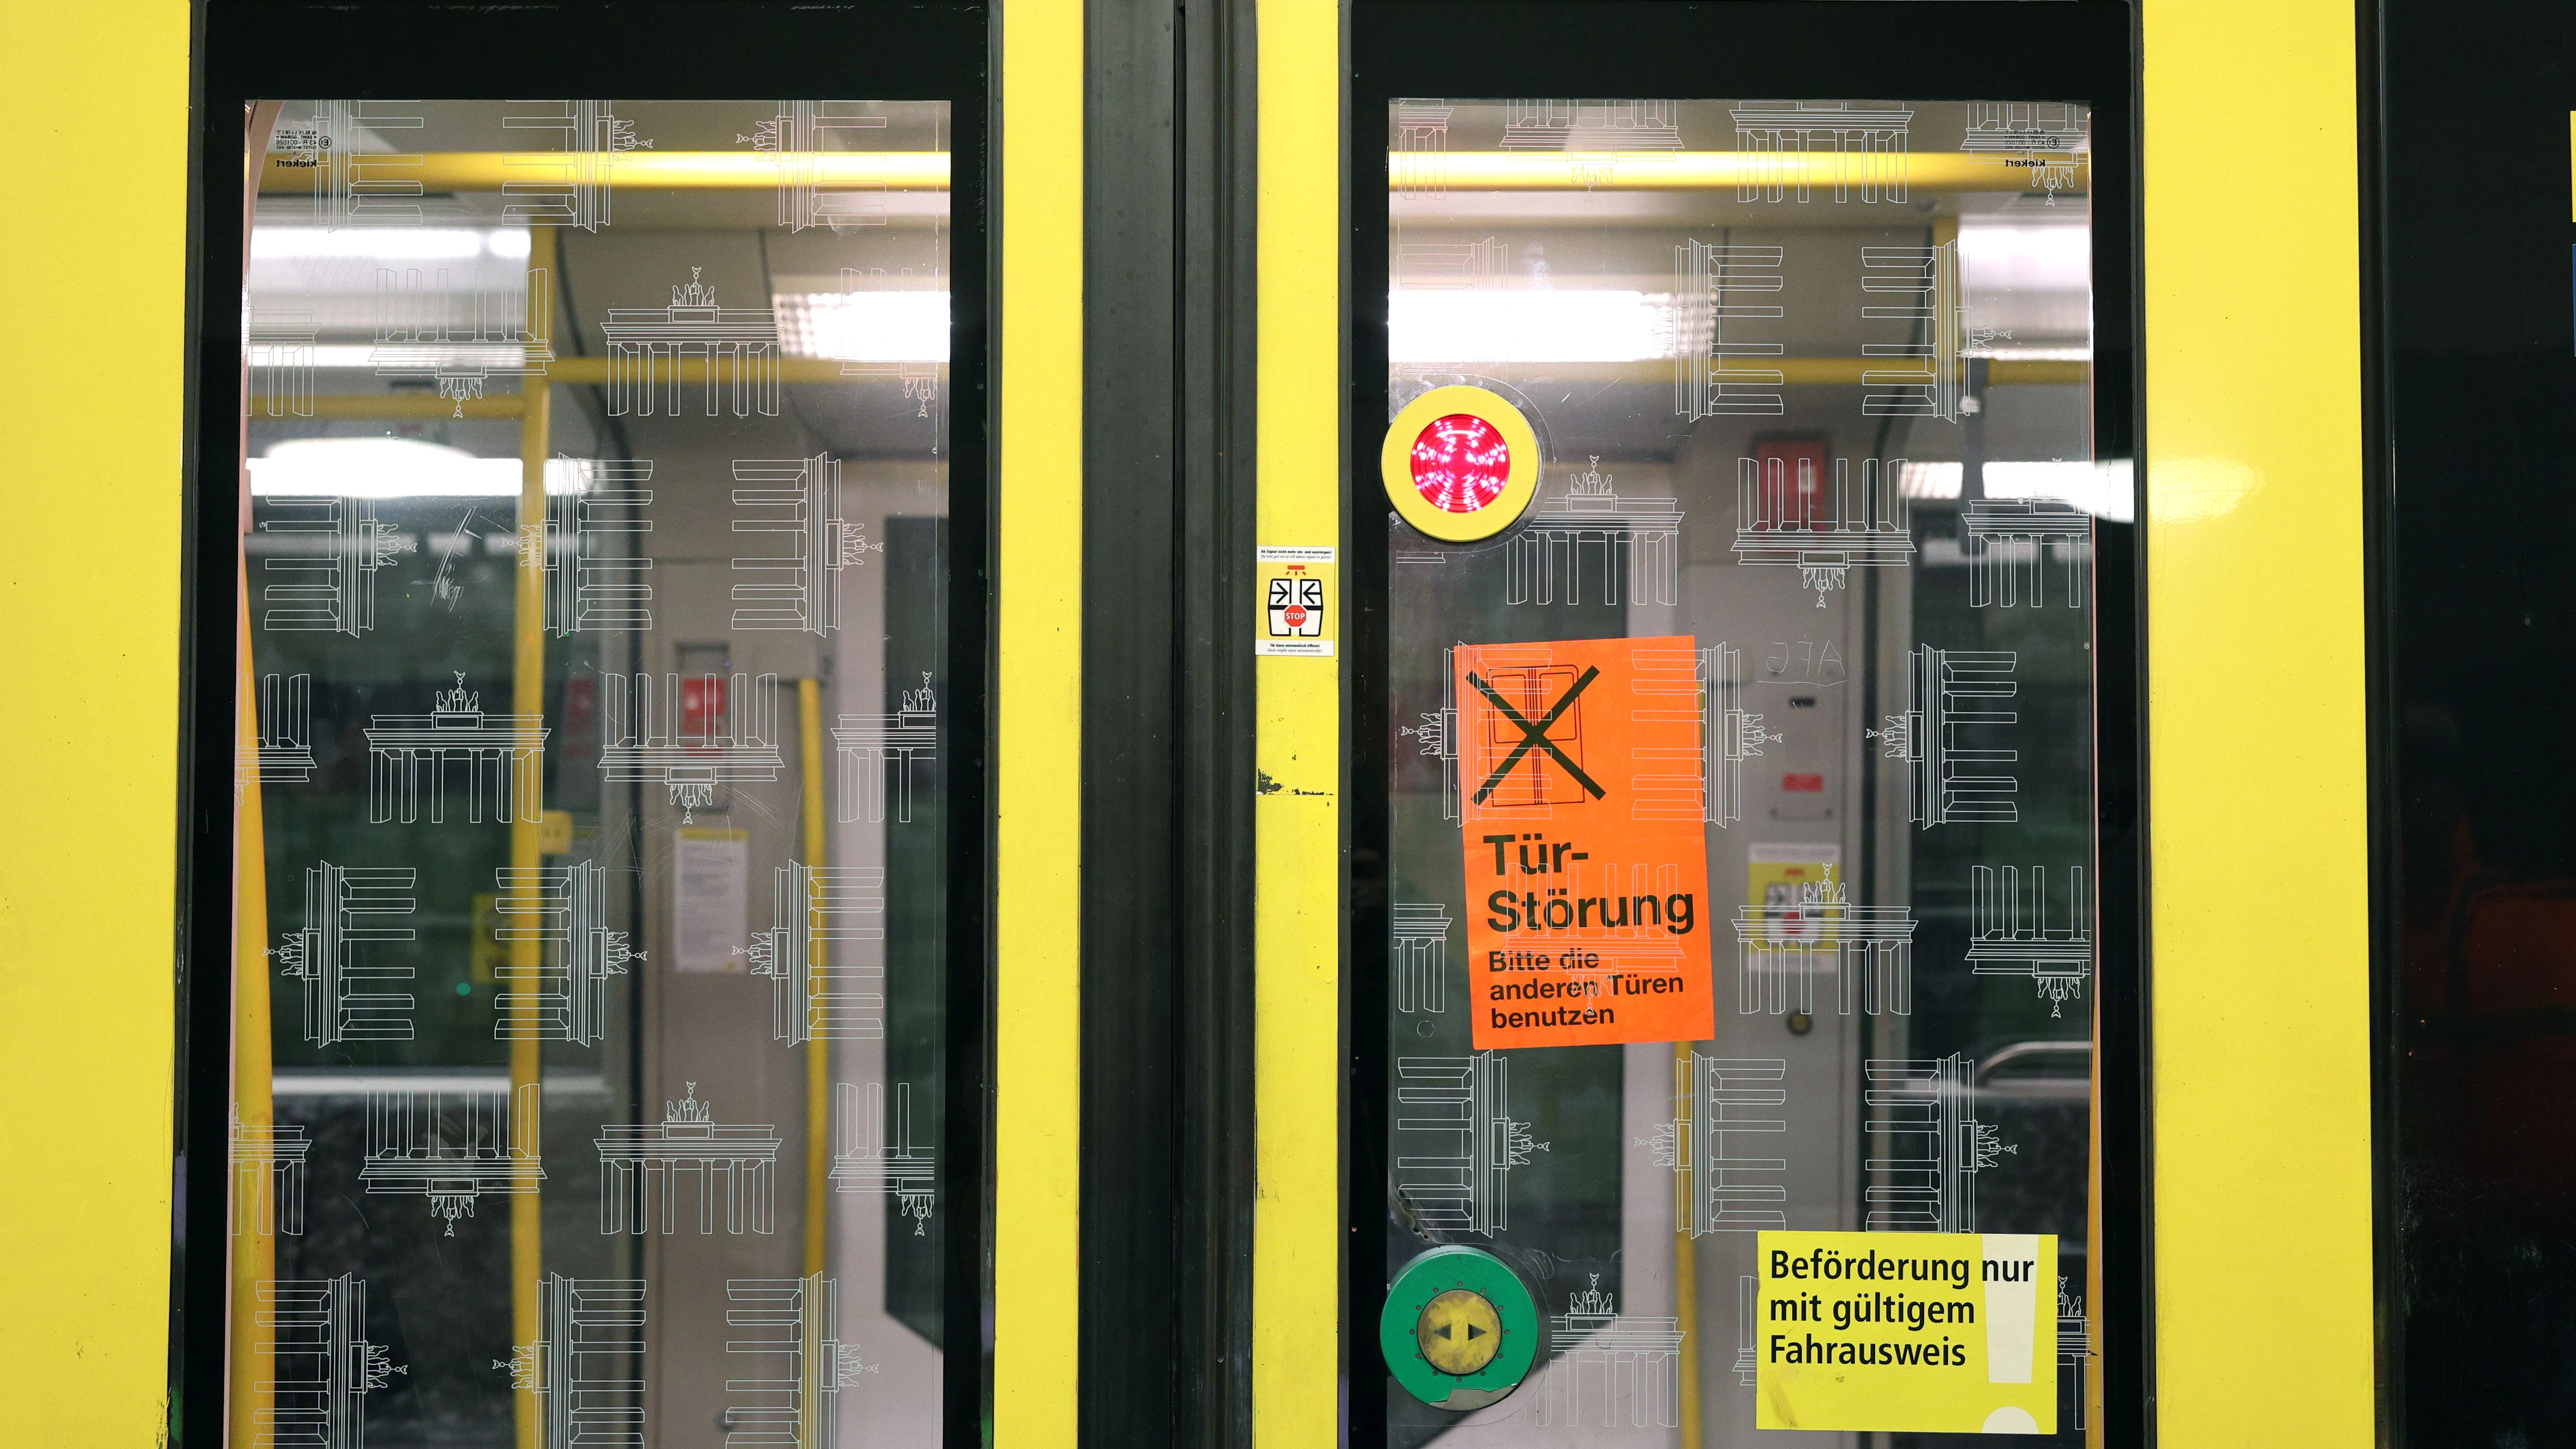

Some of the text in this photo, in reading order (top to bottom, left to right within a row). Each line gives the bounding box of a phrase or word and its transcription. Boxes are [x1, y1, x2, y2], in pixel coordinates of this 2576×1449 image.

[1484, 833, 1588, 876] Tür-
[1488, 889, 1694, 935] Störung
[1490, 948, 1599, 972] Bitte die
[1490, 974, 1684, 1001] anderen Türen
[1491, 1006, 1614, 1028] benutzen
[1771, 1248, 2034, 1289] Beförderung nur
[1771, 1292, 1974, 1330] mit gültigem
[1771, 1333, 1966, 1366] Fahrausweis
